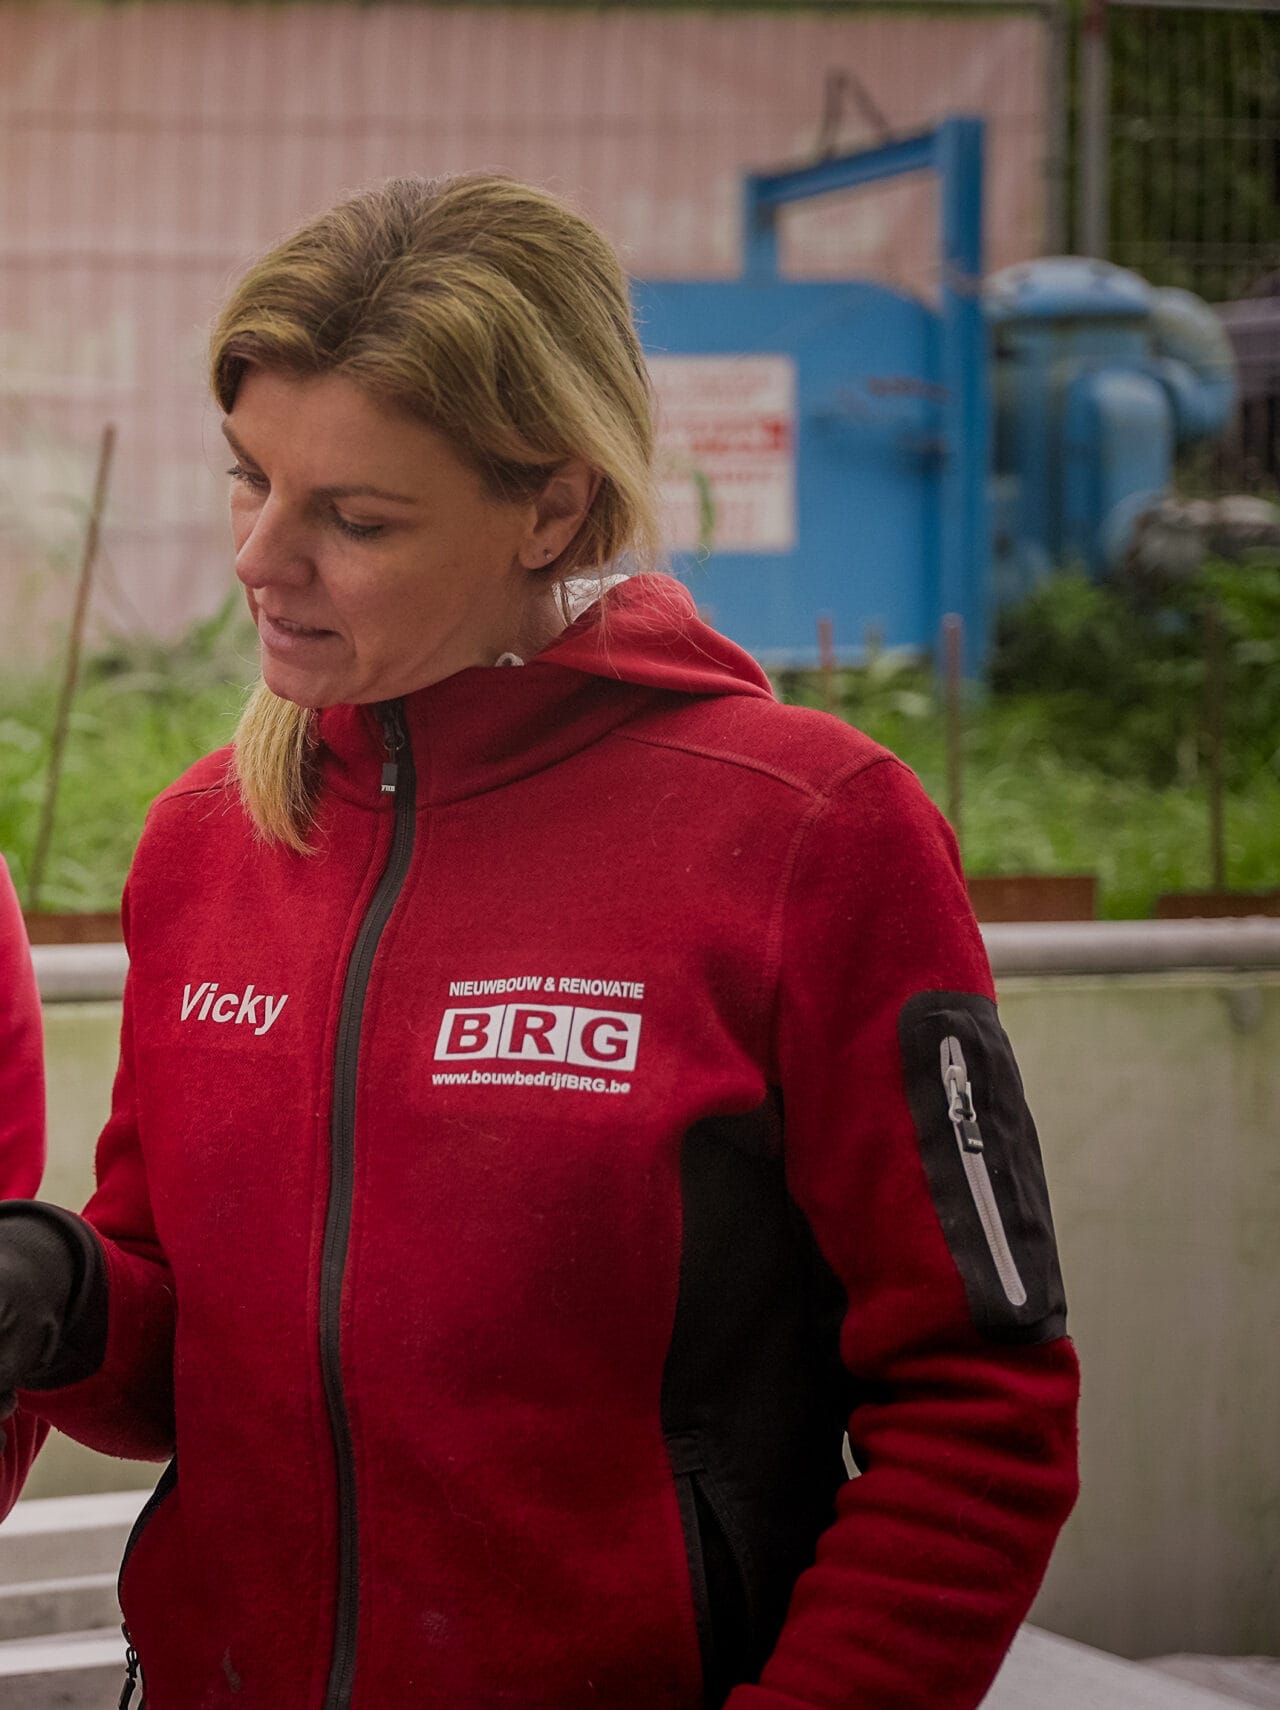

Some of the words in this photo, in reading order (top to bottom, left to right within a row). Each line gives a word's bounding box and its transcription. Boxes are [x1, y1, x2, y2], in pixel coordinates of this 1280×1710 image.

[449, 976, 543, 997] NIEUWBOUW
[544, 976, 556, 992] &
[559, 978, 645, 999] RENOVATIE
[180, 982, 289, 1036] Vicky
[444, 1008, 631, 1063] BRG
[431, 1069, 631, 1094] www.bouwbedrijfBRG.be
